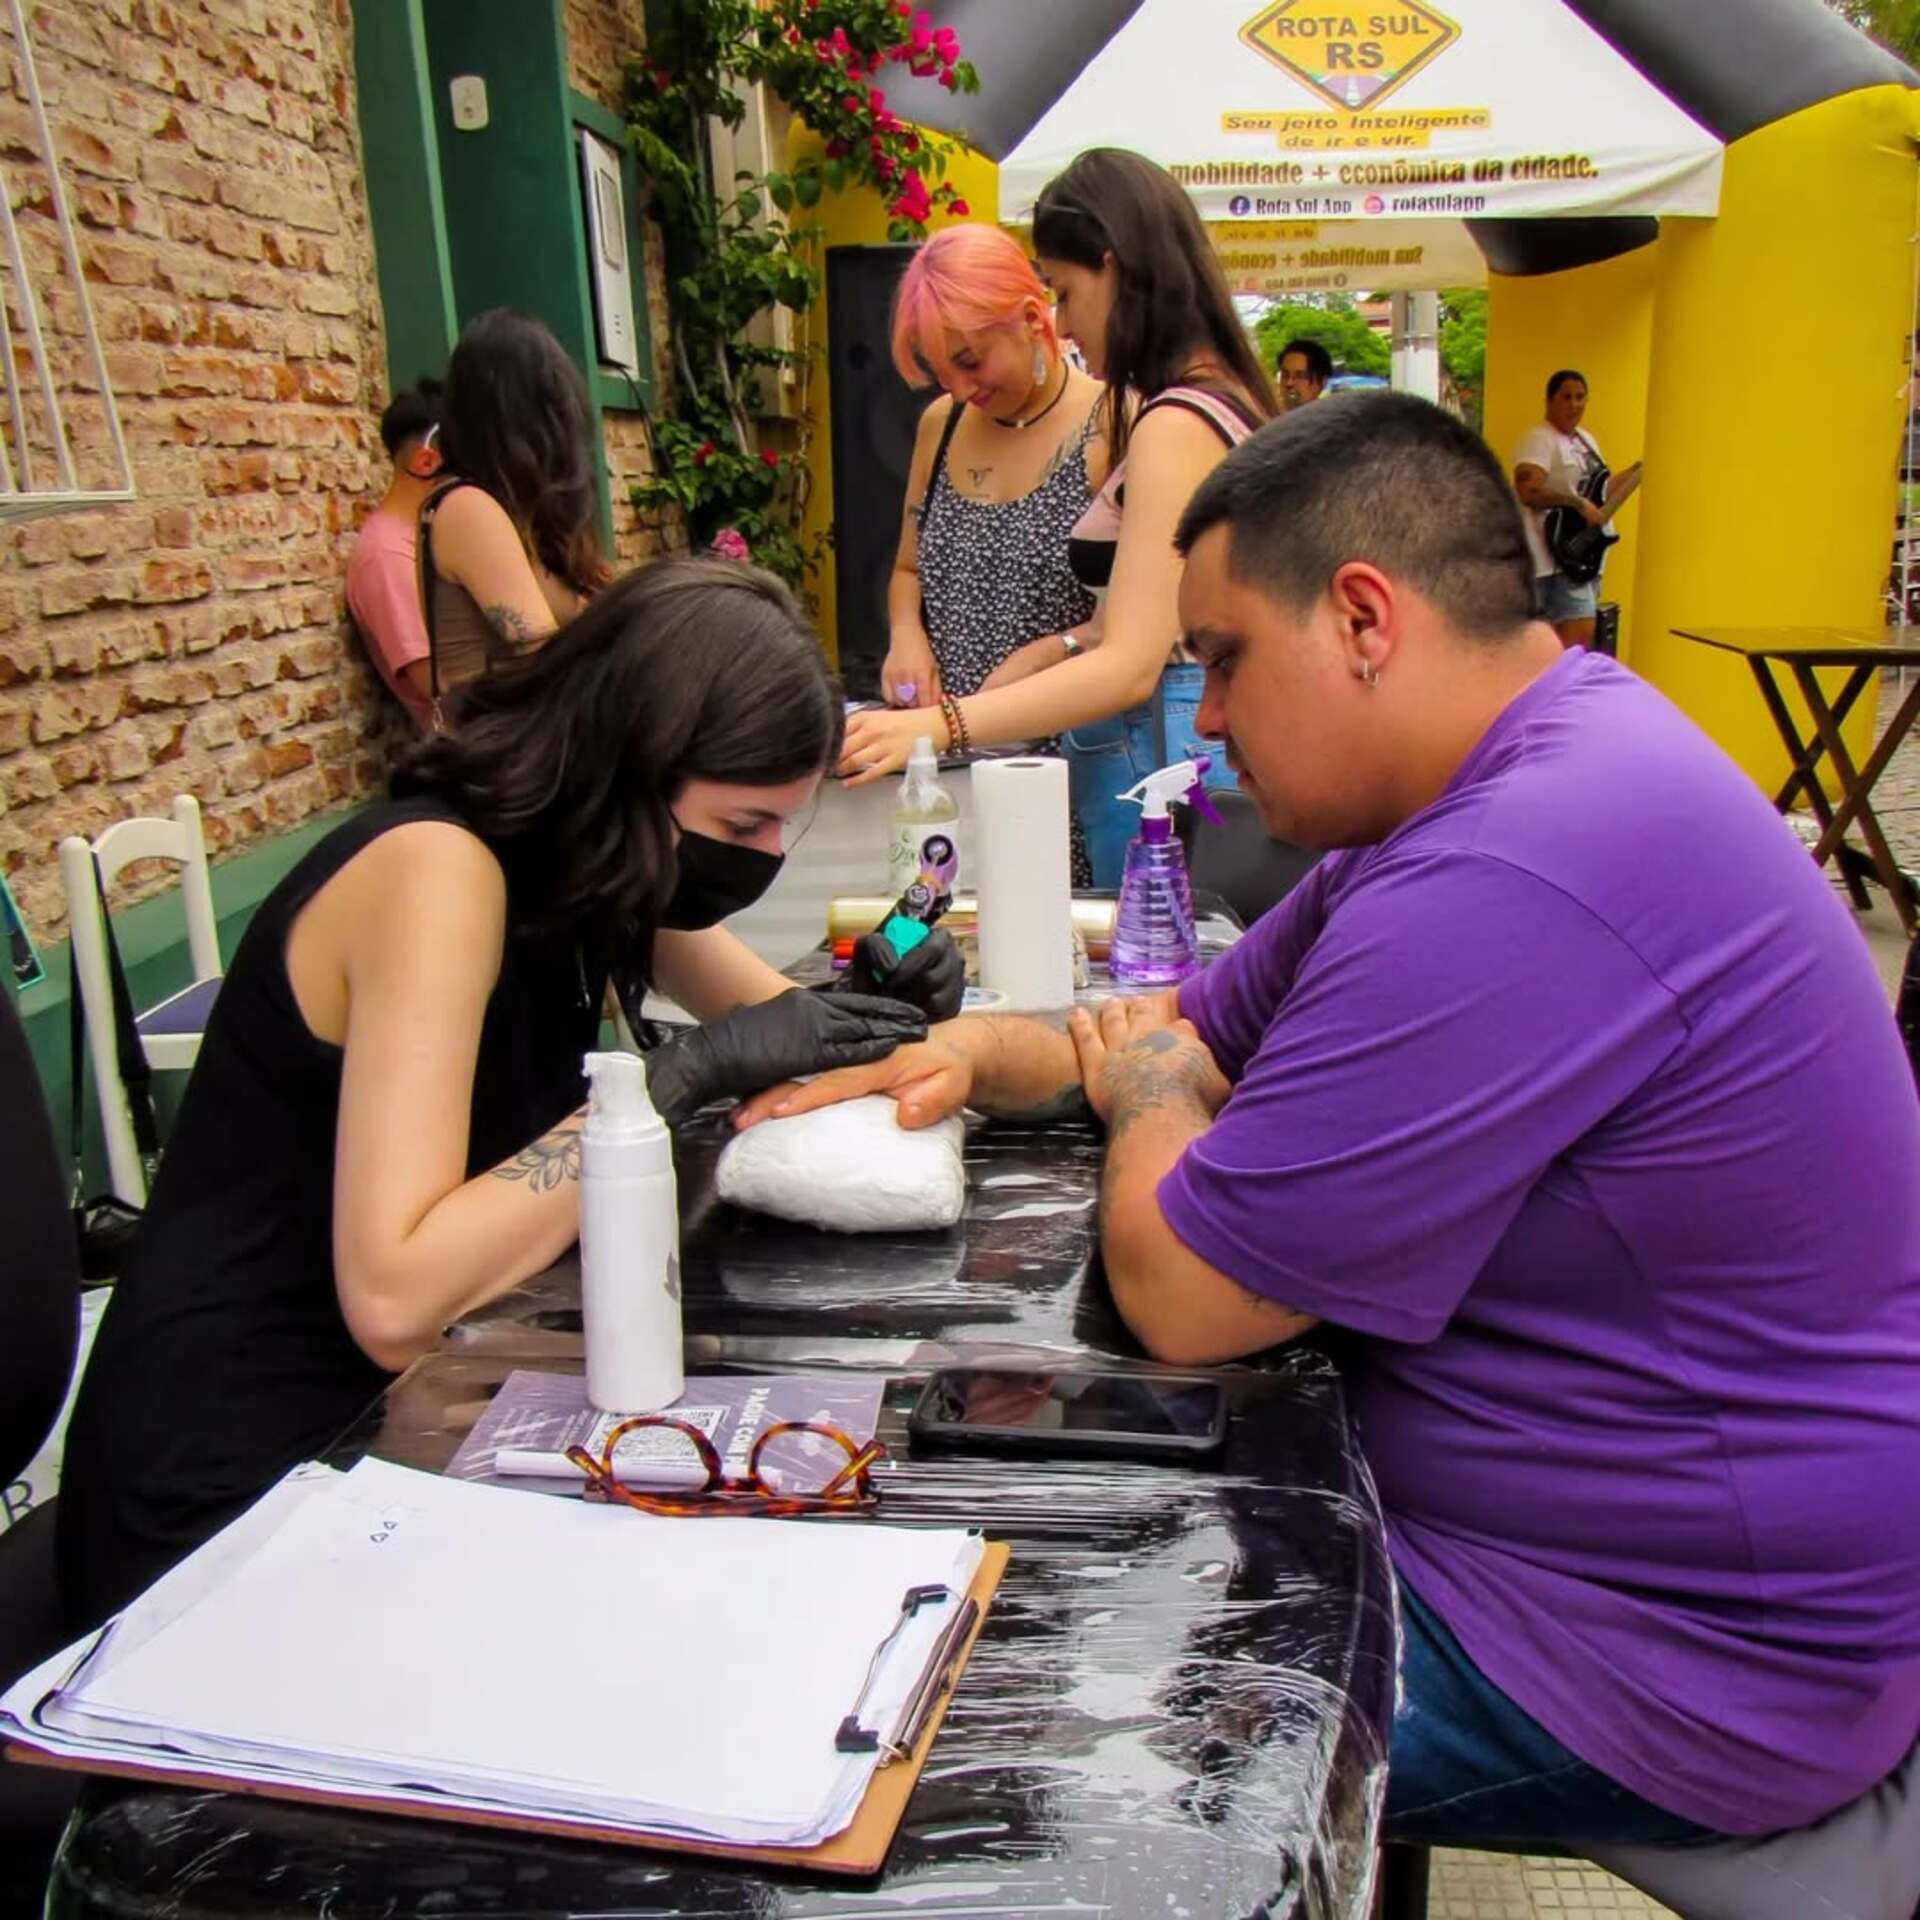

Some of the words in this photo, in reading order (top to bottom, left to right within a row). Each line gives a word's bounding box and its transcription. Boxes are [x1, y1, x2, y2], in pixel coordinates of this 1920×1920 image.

[1276, 16, 1358, 38] ROTA
[1368, 15, 1429, 36] SUL
[1326, 41, 1384, 69] RS
[1225, 116, 1272, 130] Seu
[1281, 115, 1338, 132] jeito
[1350, 113, 1486, 131] Inteligente
[1284, 135, 1318, 148] de
[1325, 134, 1344, 147] ir
[1355, 136, 1369, 147] e
[1381, 133, 1417, 146] vir.
[1170, 161, 1303, 186] mobilidade
[1312, 165, 1330, 182] +
[1339, 158, 1466, 185] econômica
[1472, 159, 1504, 182] da
[1510, 153, 1600, 180] cidade.
[1255, 199, 1291, 215] Rota
[1297, 198, 1318, 214] Sul
